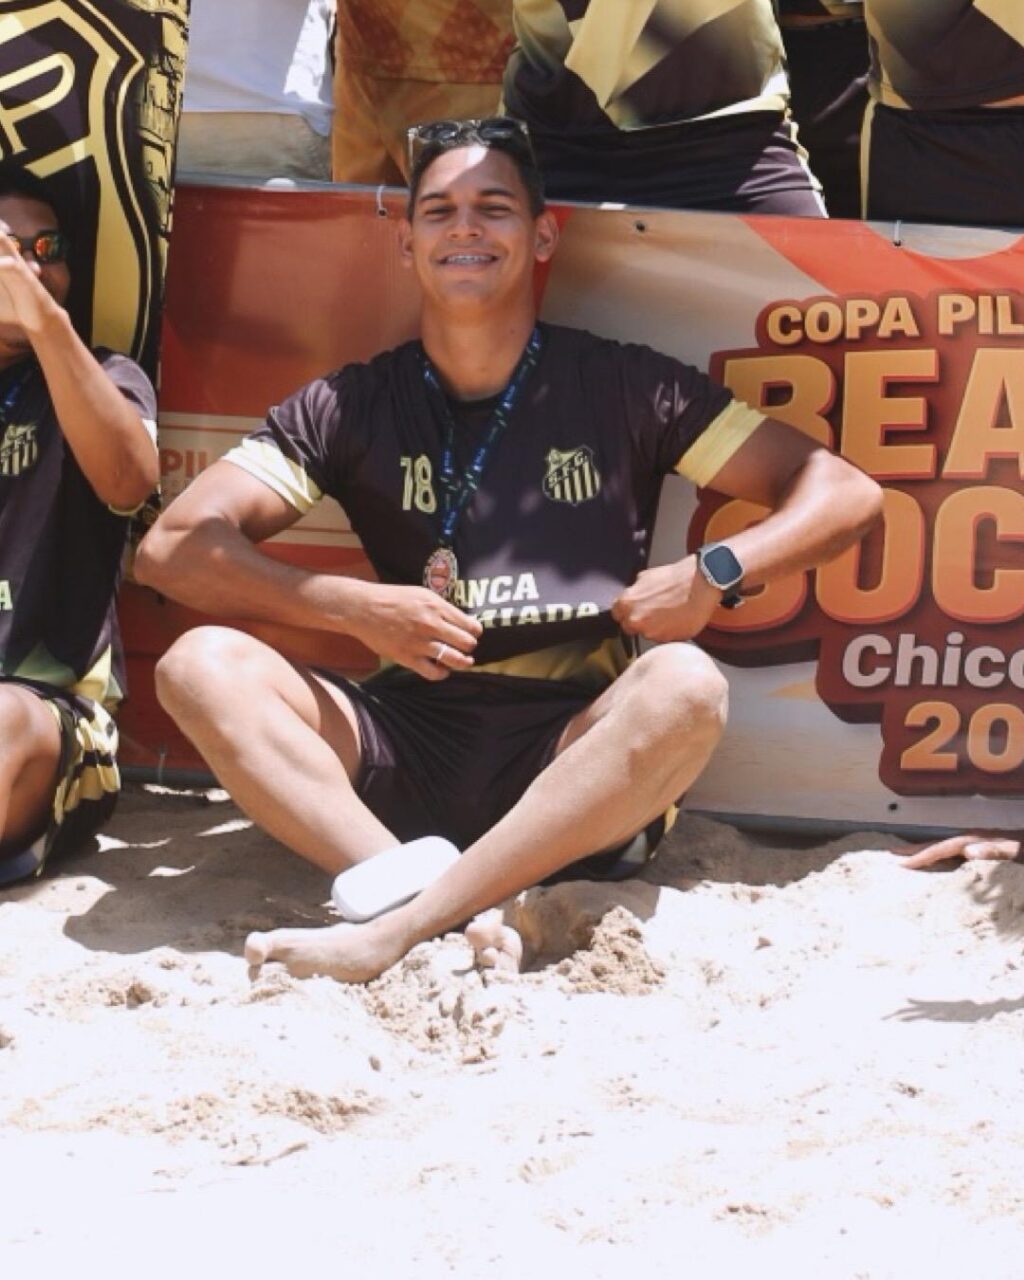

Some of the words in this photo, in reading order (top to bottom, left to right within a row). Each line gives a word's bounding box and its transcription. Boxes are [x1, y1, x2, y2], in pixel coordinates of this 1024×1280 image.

[766, 297, 918, 344] COPA
[401, 455, 437, 514] 18
[453, 572, 539, 608] ANCA
